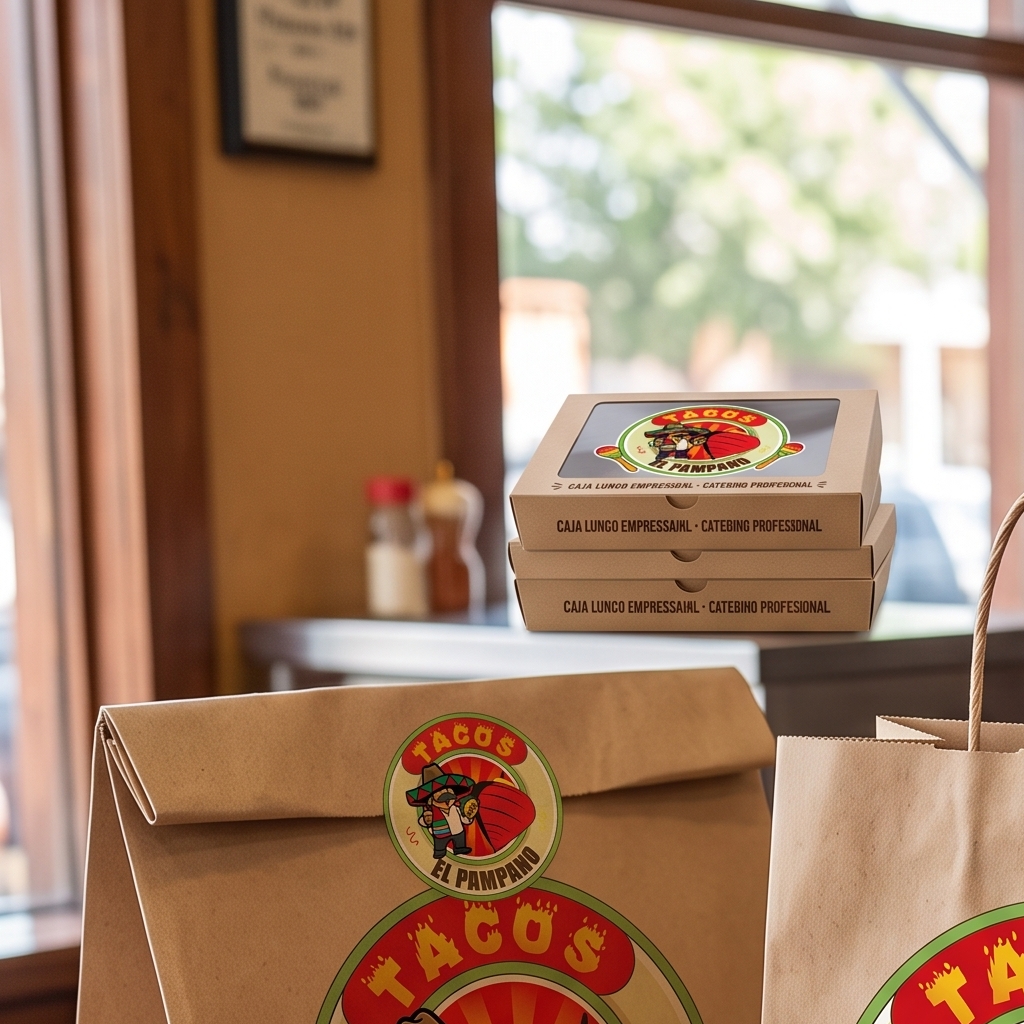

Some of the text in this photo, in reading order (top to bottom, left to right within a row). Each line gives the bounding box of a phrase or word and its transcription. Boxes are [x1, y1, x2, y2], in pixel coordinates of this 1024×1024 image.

[668, 457, 752, 473] PAMPANO
[556, 519, 582, 533] CAJA
[563, 600, 588, 614] CAJA
[760, 600, 831, 614] PROFESIONAL
[411, 722, 516, 763] TACOS
[430, 846, 541, 891] EL PAMPANO
[361, 898, 607, 1008] TACOS
